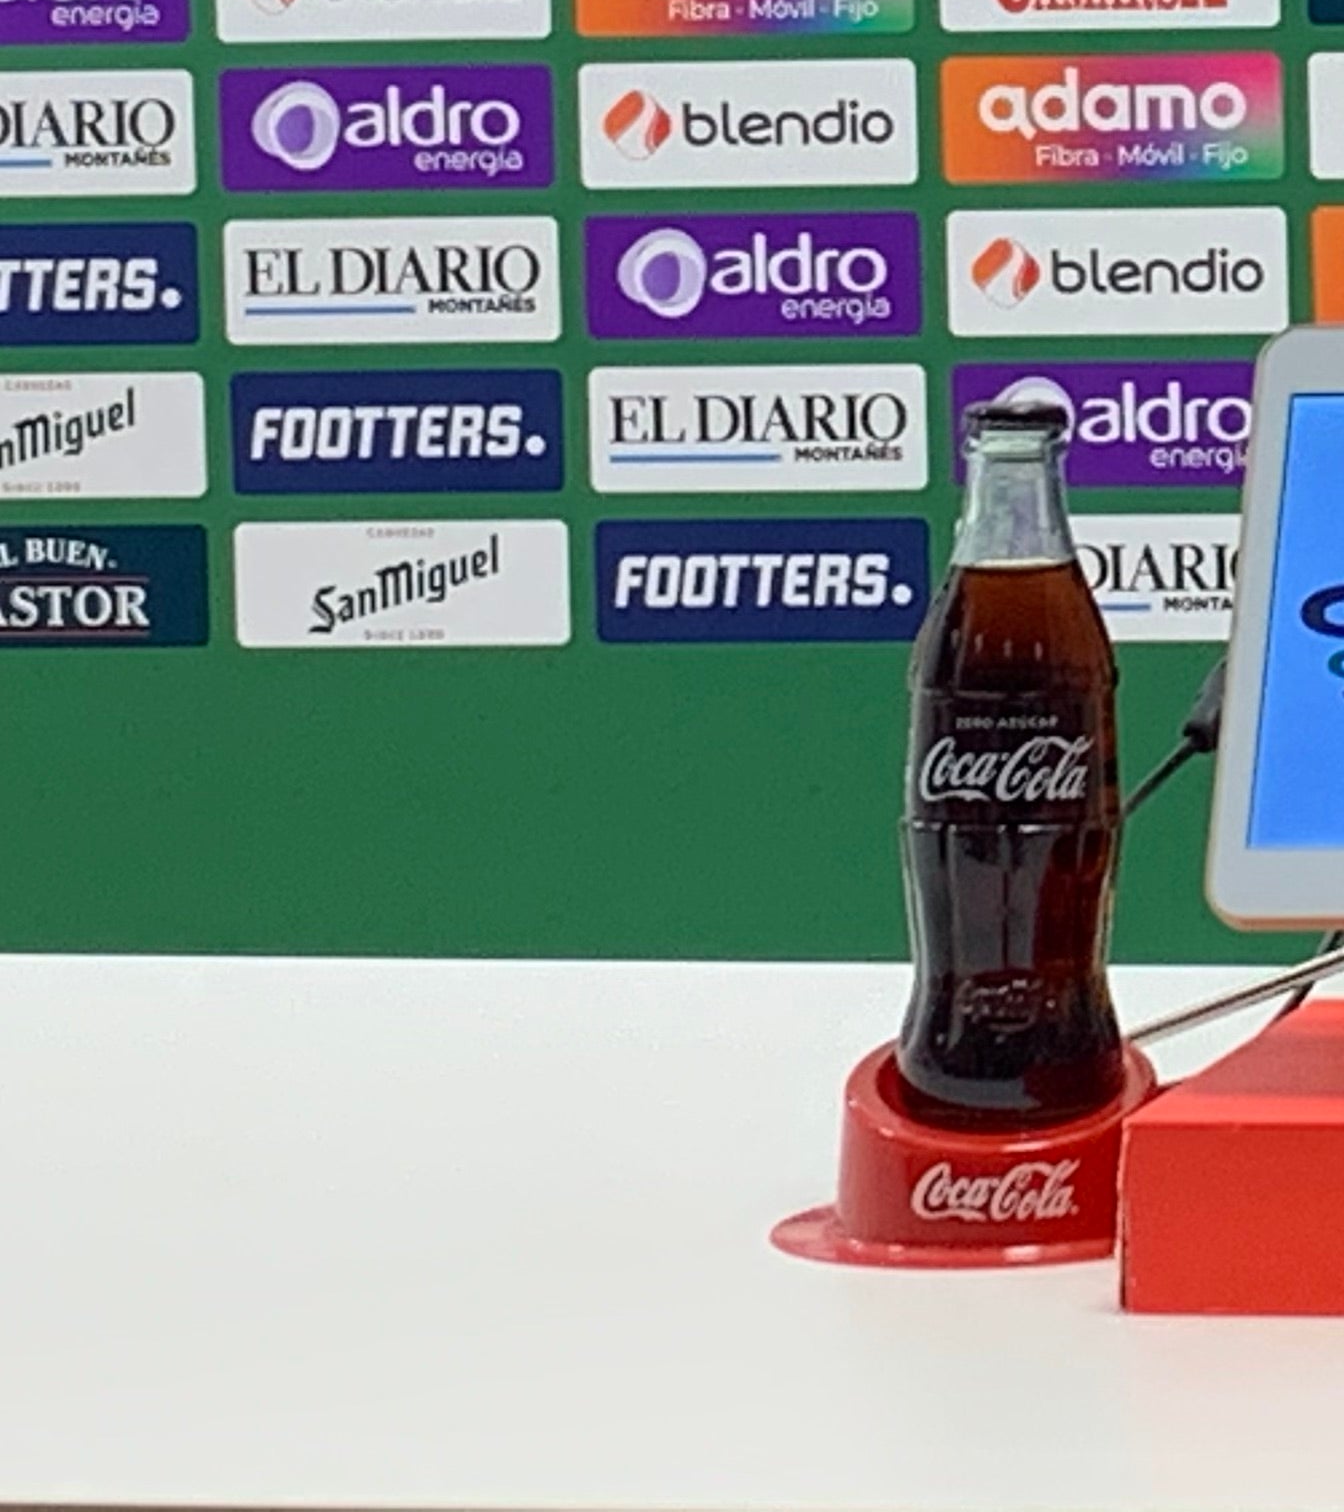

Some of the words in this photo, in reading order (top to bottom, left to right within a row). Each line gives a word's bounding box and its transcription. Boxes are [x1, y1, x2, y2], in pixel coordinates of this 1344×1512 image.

[682, 99, 895, 147] blendio
[978, 65, 1247, 140] adamo
[1034, 143, 1100, 167] Fibra
[1116, 141, 1185, 167] Móvil
[1202, 142, 1248, 171] Fijo
[245, 248, 321, 297] EL
[329, 244, 541, 298] DIARIO
[709, 231, 887, 295] aldro
[1051, 247, 1265, 295] blendio
[919, 735, 1094, 802] Coca-Cola
[910, 1158, 1081, 1222] Coca-Cola
